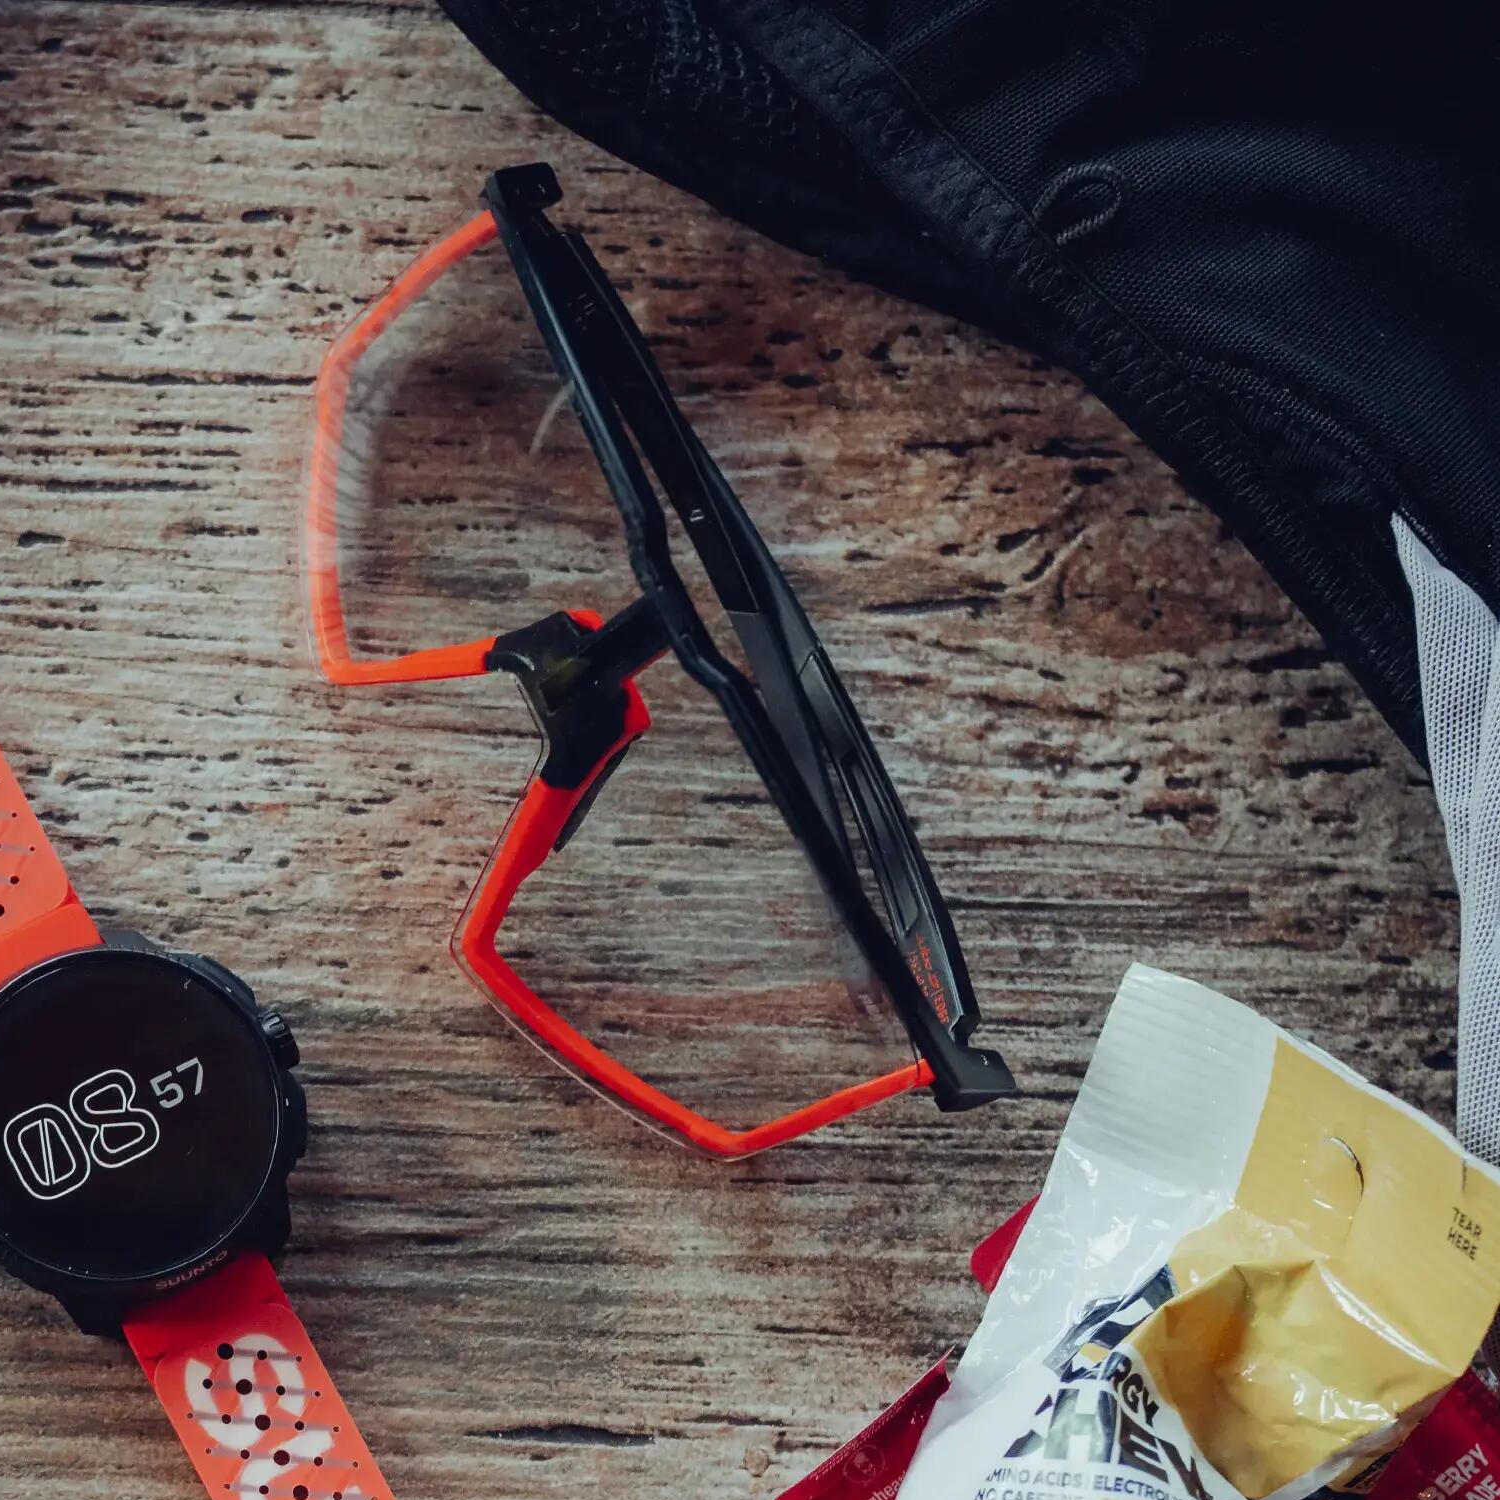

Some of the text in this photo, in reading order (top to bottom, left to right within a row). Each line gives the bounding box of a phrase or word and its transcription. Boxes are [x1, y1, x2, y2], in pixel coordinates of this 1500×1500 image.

[3, 1056, 204, 1200] 08 57
[1452, 1206, 1483, 1241] TEAR
[1446, 1227, 1479, 1261] HERE
[154, 1250, 229, 1290] SUUNTO
[1033, 1470, 1083, 1488] ACIDS
